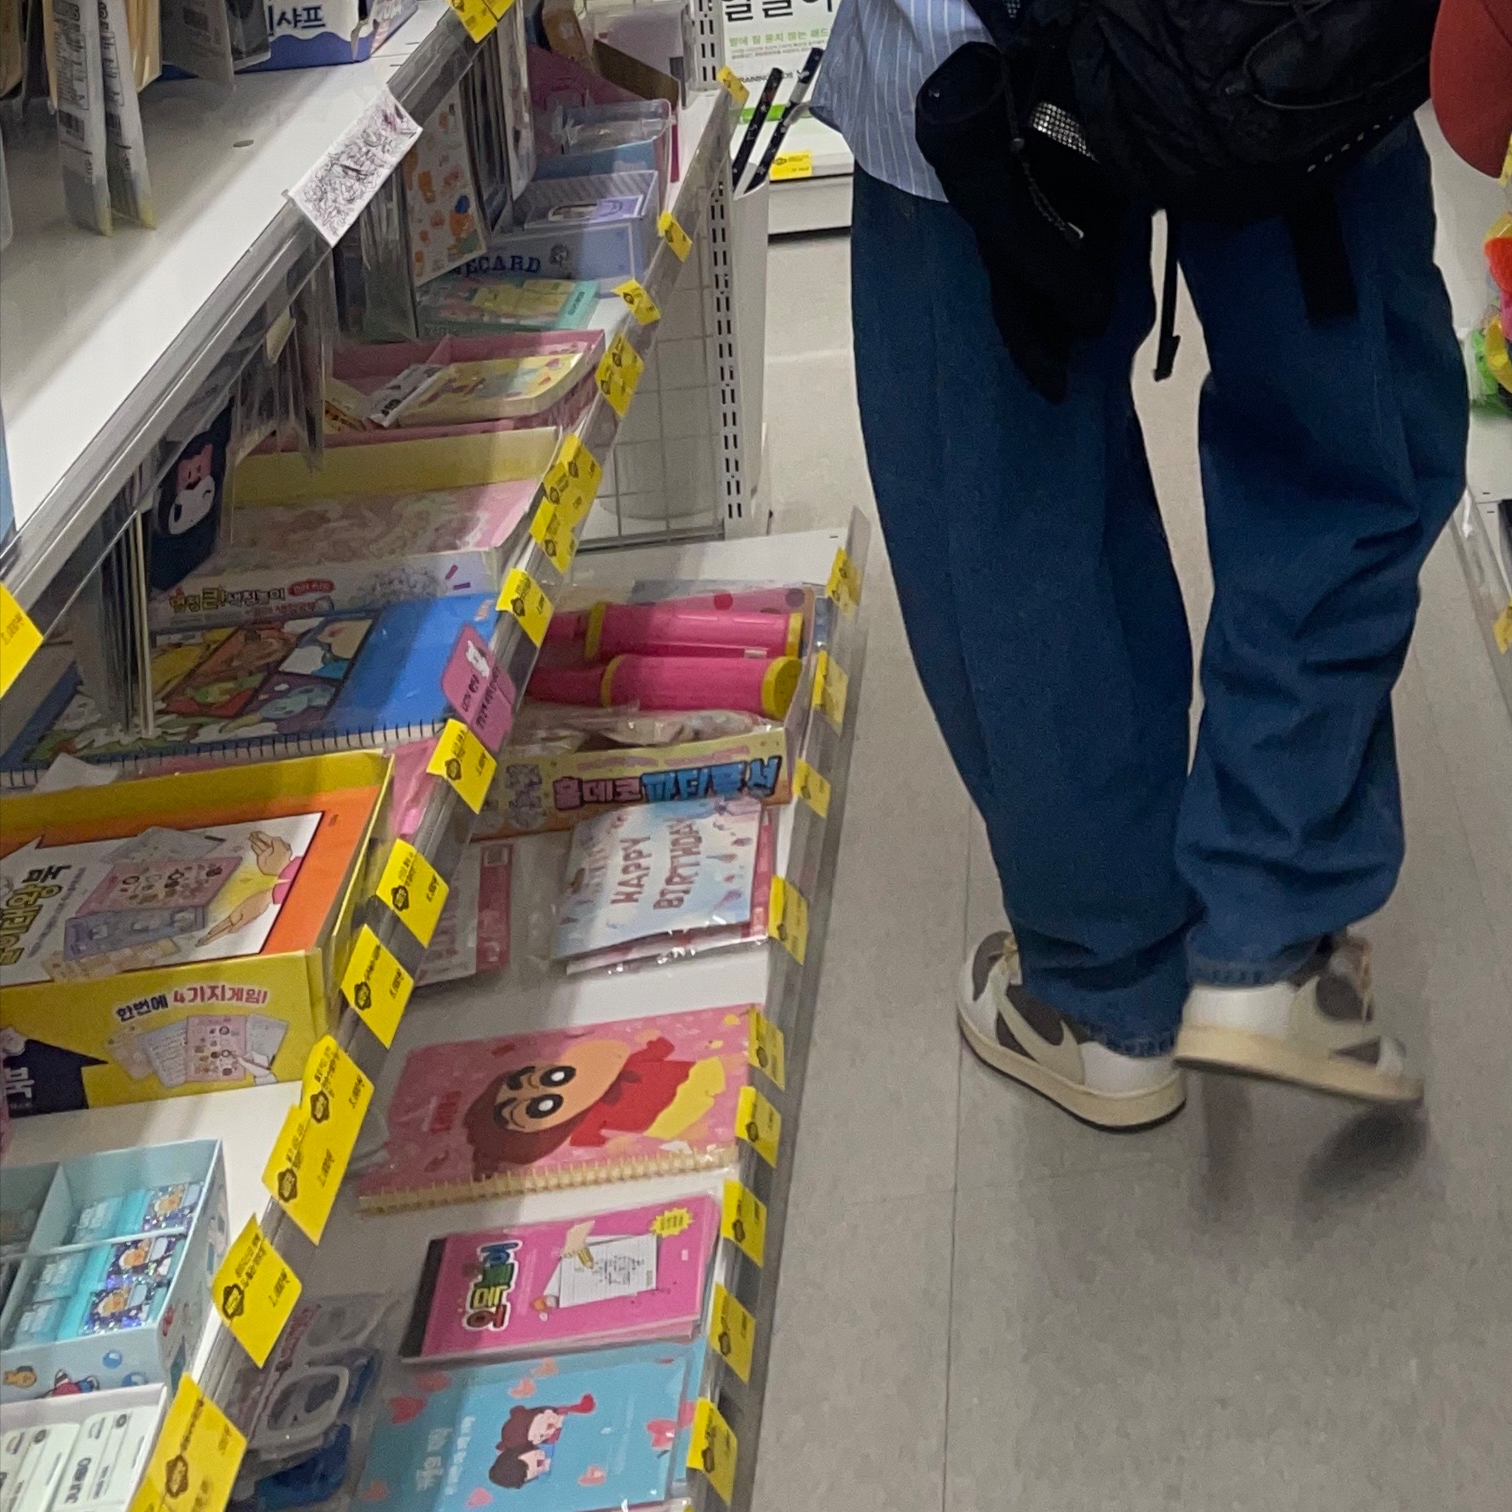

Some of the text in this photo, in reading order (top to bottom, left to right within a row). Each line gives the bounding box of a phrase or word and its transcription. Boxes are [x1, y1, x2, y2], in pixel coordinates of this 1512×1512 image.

[610, 833, 651, 907] HAPPY
[652, 815, 704, 909] BIRTHDAY
[115, 982, 270, 1022] 한번에 4가지게임!
